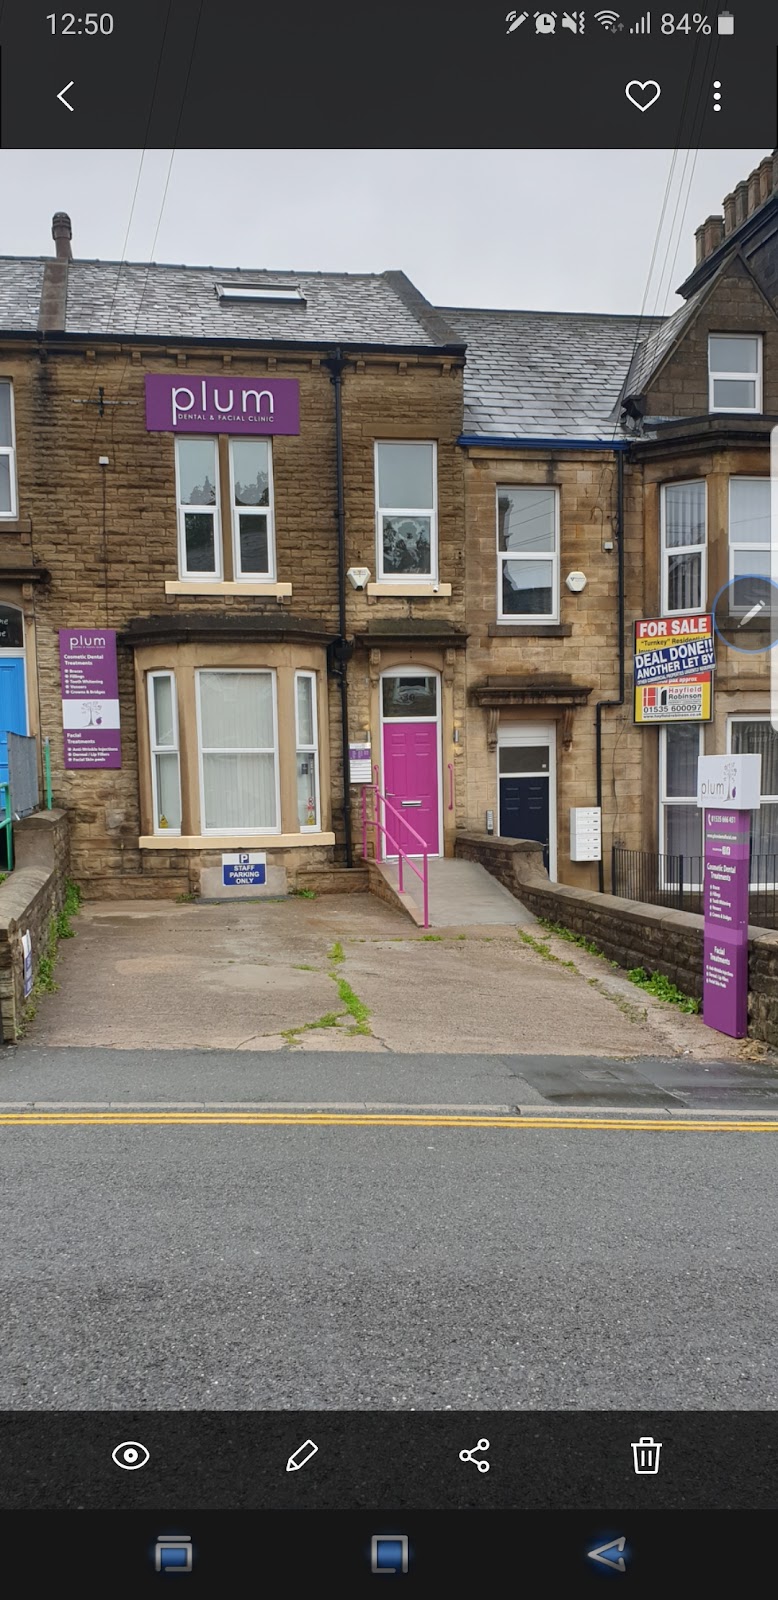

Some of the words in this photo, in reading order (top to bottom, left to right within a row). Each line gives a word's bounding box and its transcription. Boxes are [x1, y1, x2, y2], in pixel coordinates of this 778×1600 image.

[171, 380, 274, 426] plum
[639, 621, 667, 637] FOR
[671, 617, 707, 635] SALE
[70, 635, 106, 650] plum
[635, 650, 667, 668] DEAL
[669, 639, 713, 661] DONE!!
[637, 661, 680, 679] ANOTHER
[682, 656, 699, 669] LET
[701, 652, 714, 665] BY
[643, 705, 669, 713] 01535
[671, 704, 702, 712] 600097
[701, 779, 725, 801] plum
[706, 862, 723, 872] Cosmetic
[723, 864, 737, 874] Dental
[711, 871, 731, 882] Treatments
[714, 945, 726, 956] Facial
[709, 952, 731, 966] Treatments
